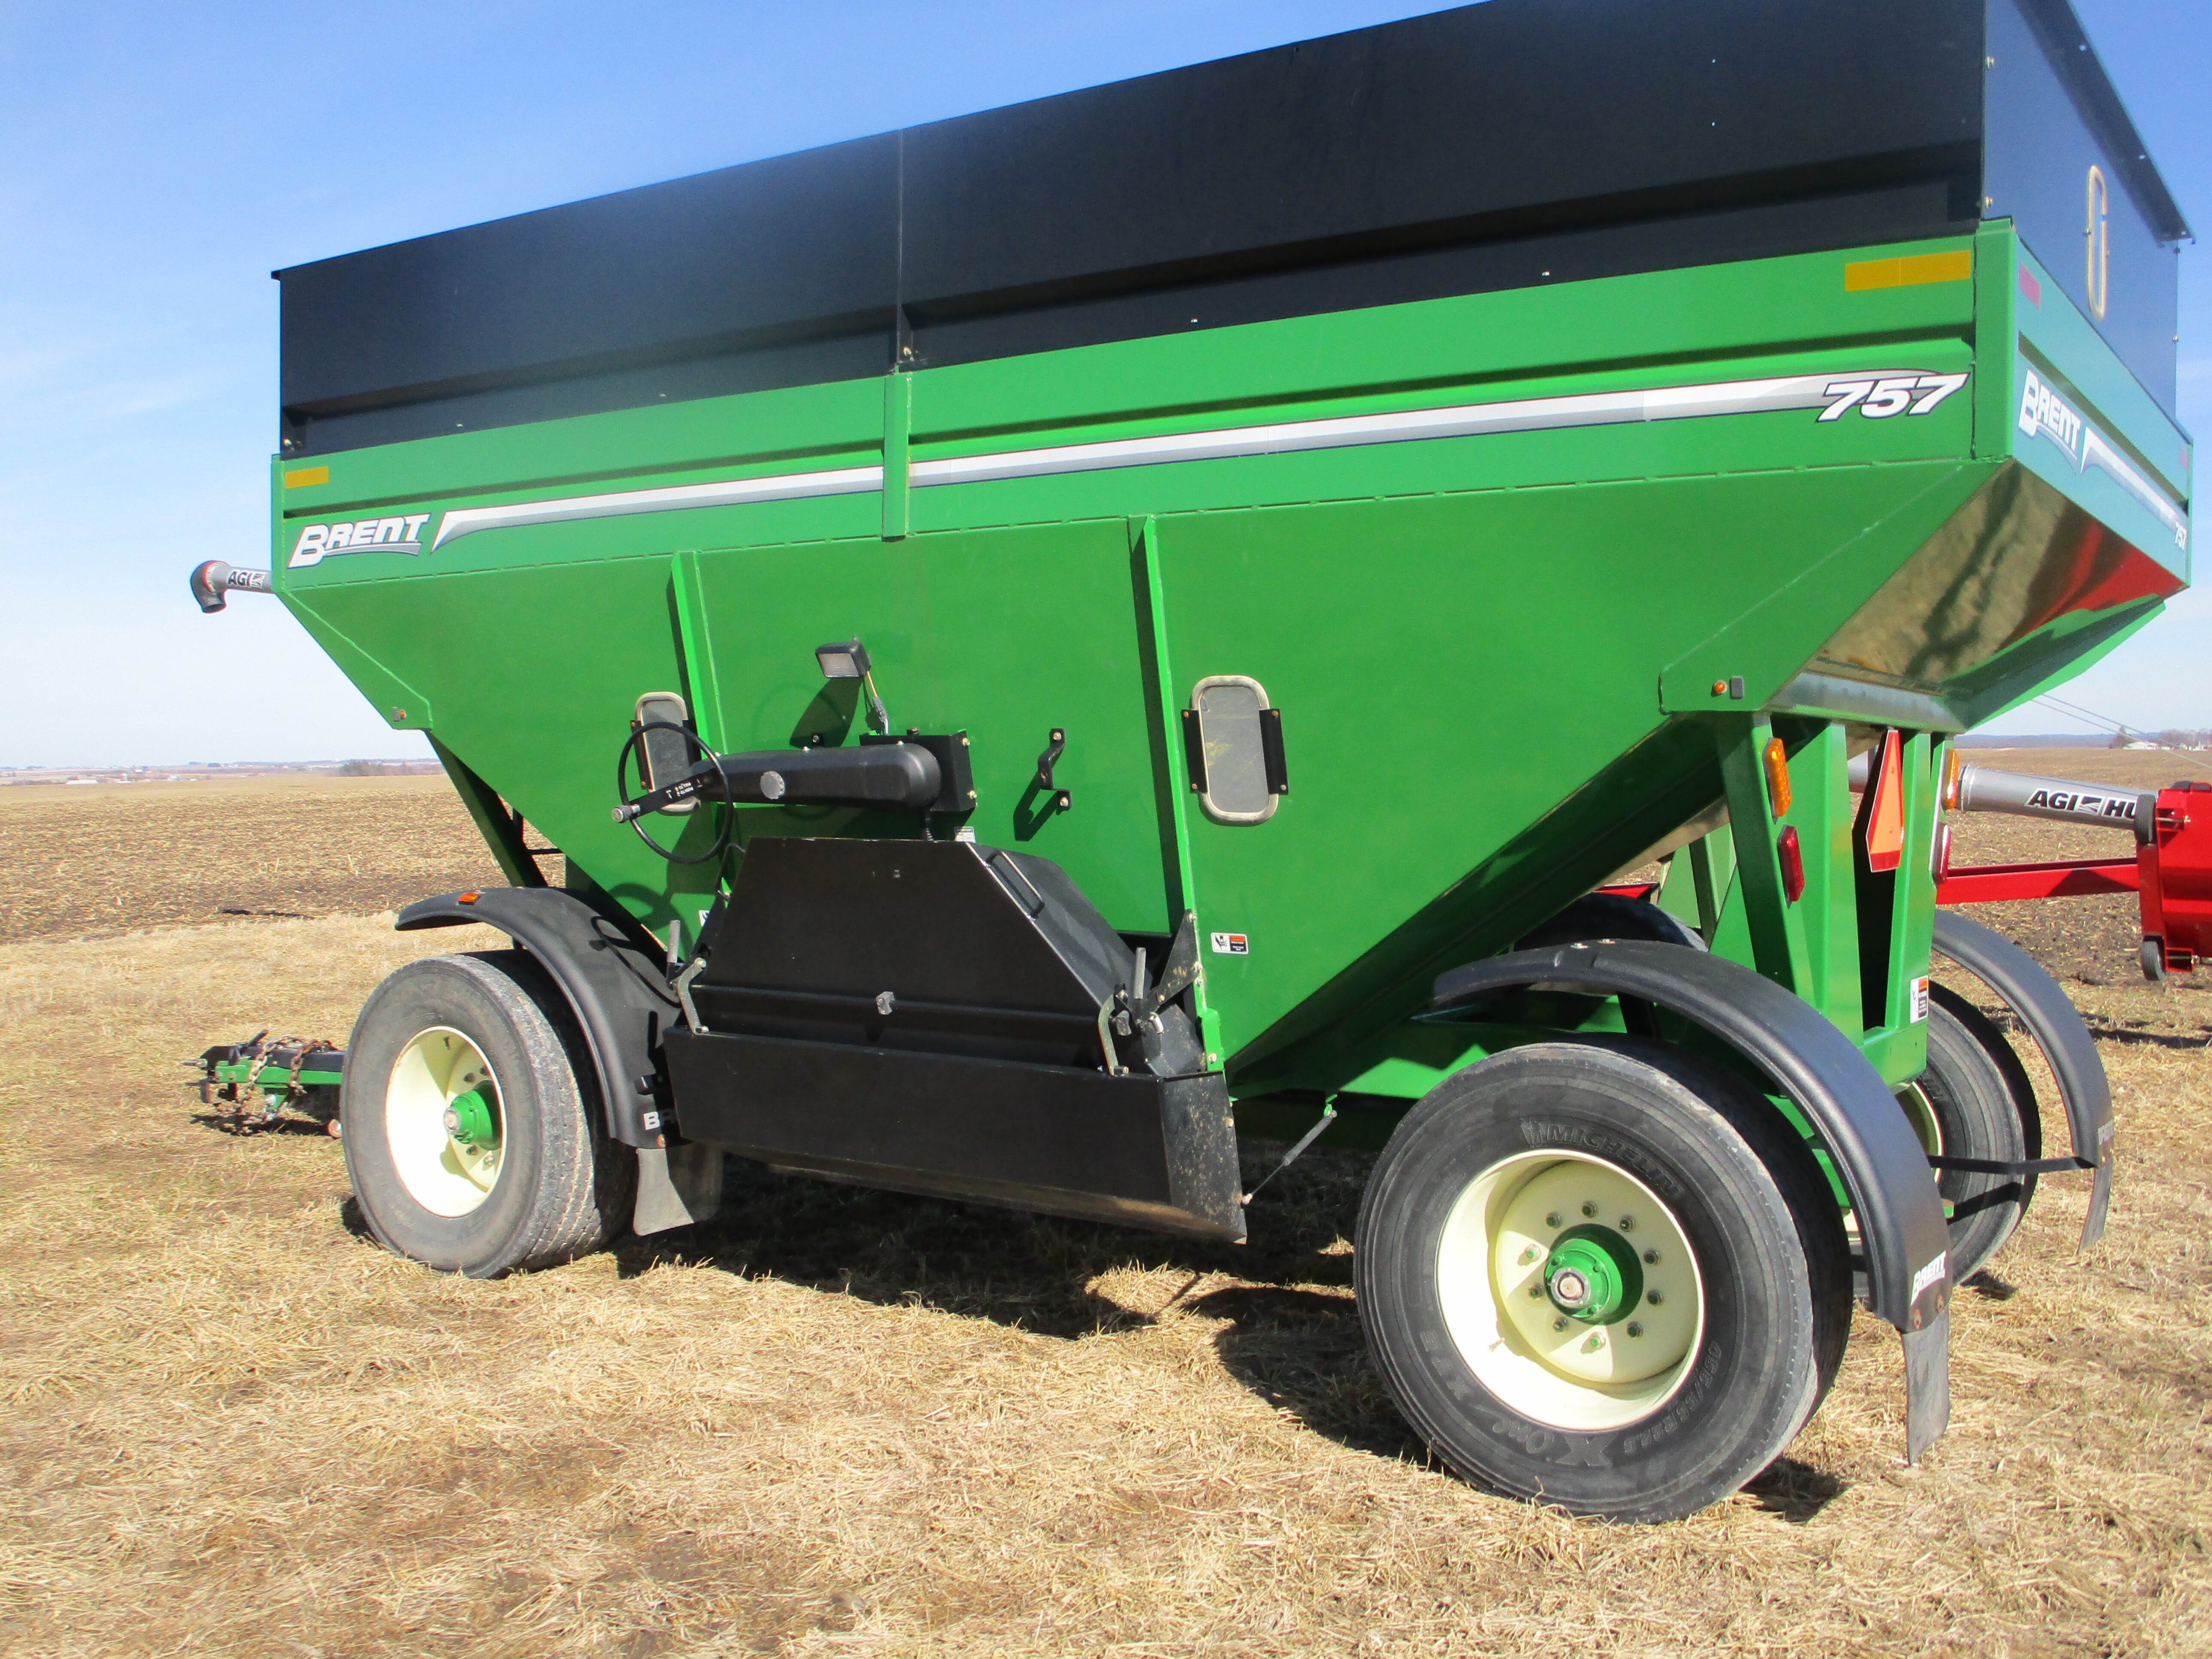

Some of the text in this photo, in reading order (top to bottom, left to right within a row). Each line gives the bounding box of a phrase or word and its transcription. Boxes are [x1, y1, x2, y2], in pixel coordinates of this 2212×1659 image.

[1815, 372, 1972, 422] 757
[2018, 370, 2081, 453] BRENT
[286, 513, 431, 570] BRENT
[2174, 521, 2188, 551] 757
[228, 571, 252, 587] AGI
[2027, 789, 2137, 819] AGI HU
[1547, 1121, 1685, 1197] MICHELIN
[1911, 1250, 1946, 1305] BRENT
